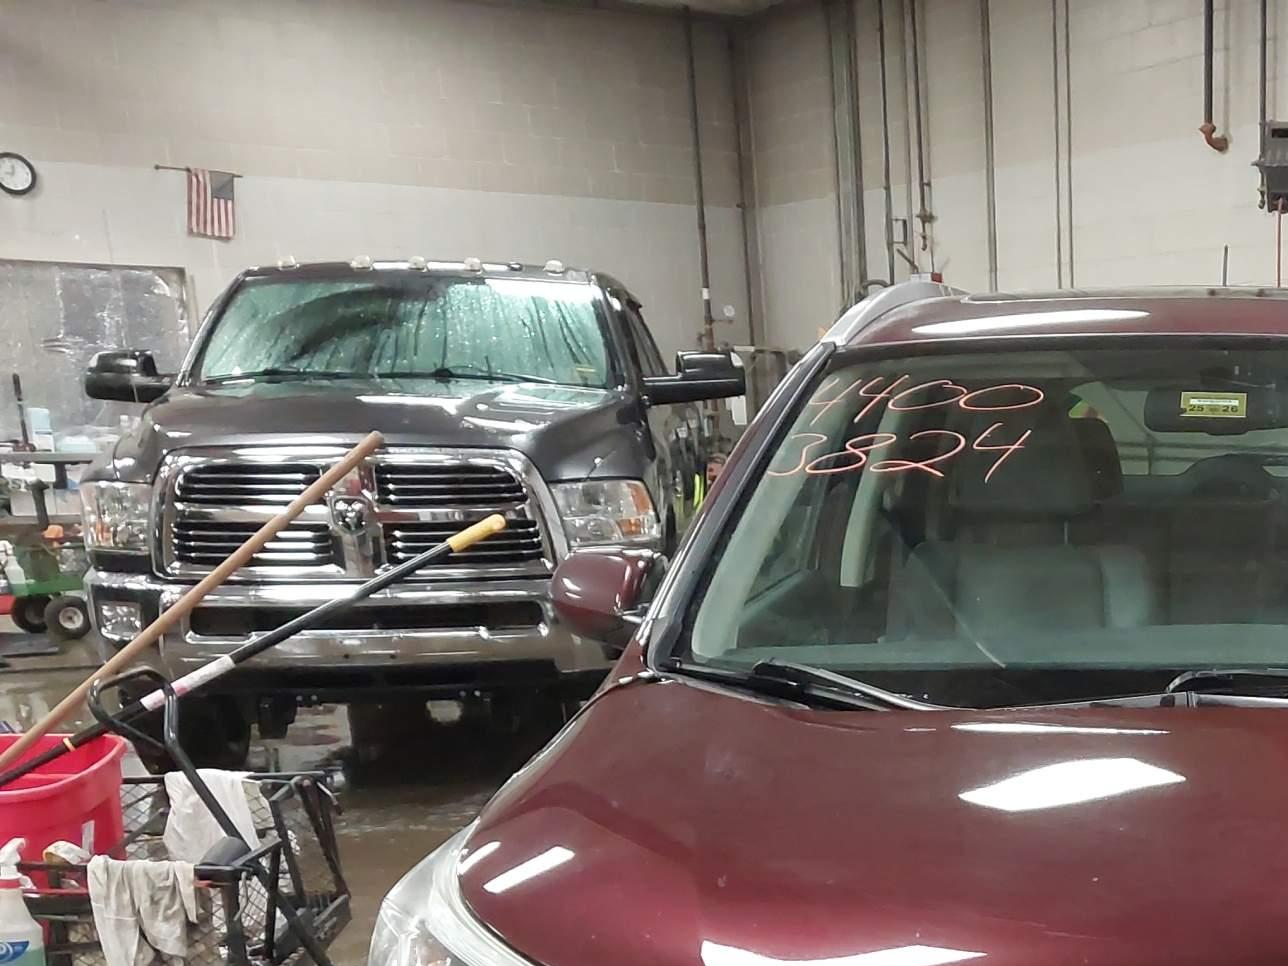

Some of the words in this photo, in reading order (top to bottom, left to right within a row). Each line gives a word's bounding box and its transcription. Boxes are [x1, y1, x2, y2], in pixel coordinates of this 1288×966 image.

[809, 374, 1044, 426] 4400
[1188, 404, 1205, 412] 25
[768, 422, 1032, 484] 3824
